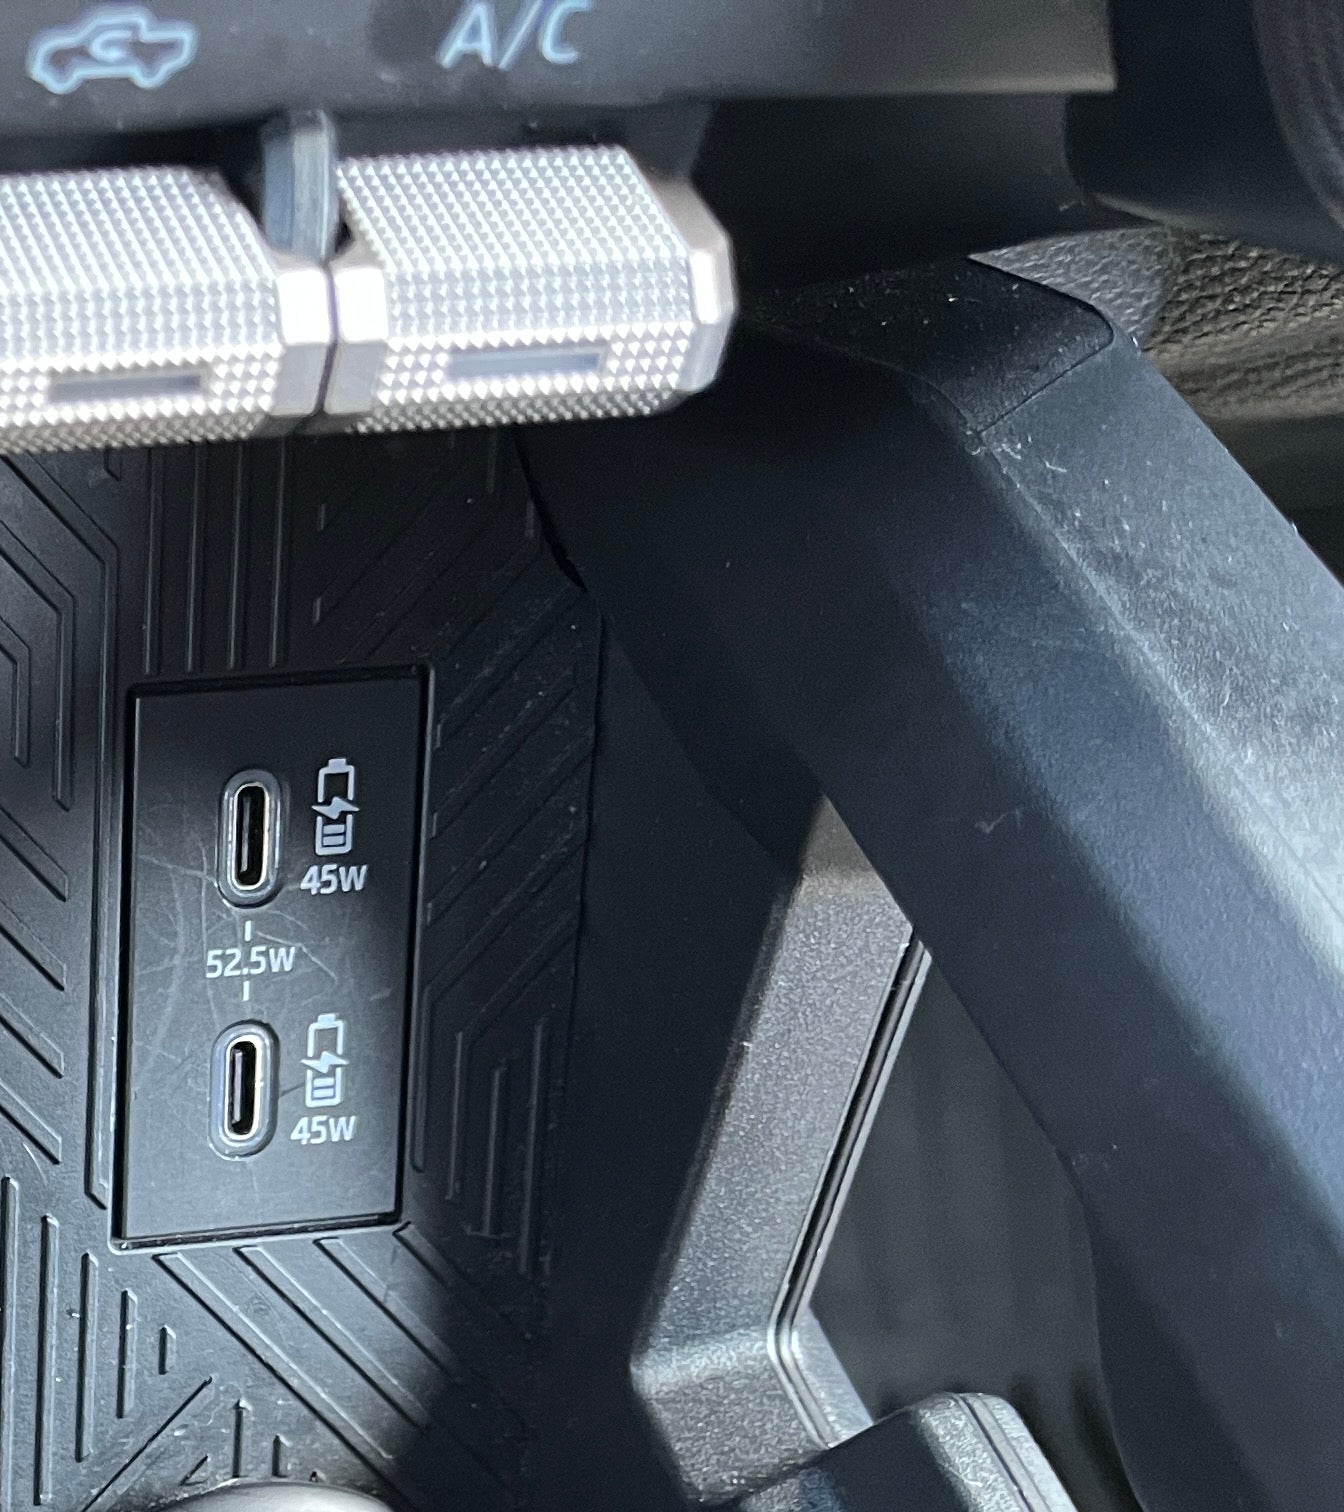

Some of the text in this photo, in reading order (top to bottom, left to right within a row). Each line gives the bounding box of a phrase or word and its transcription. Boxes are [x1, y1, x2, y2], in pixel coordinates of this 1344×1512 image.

[435, 0, 593, 70] A/C
[299, 864, 367, 895] 45W
[205, 945, 296, 978] 52.5W
[290, 1115, 356, 1144] 45W
